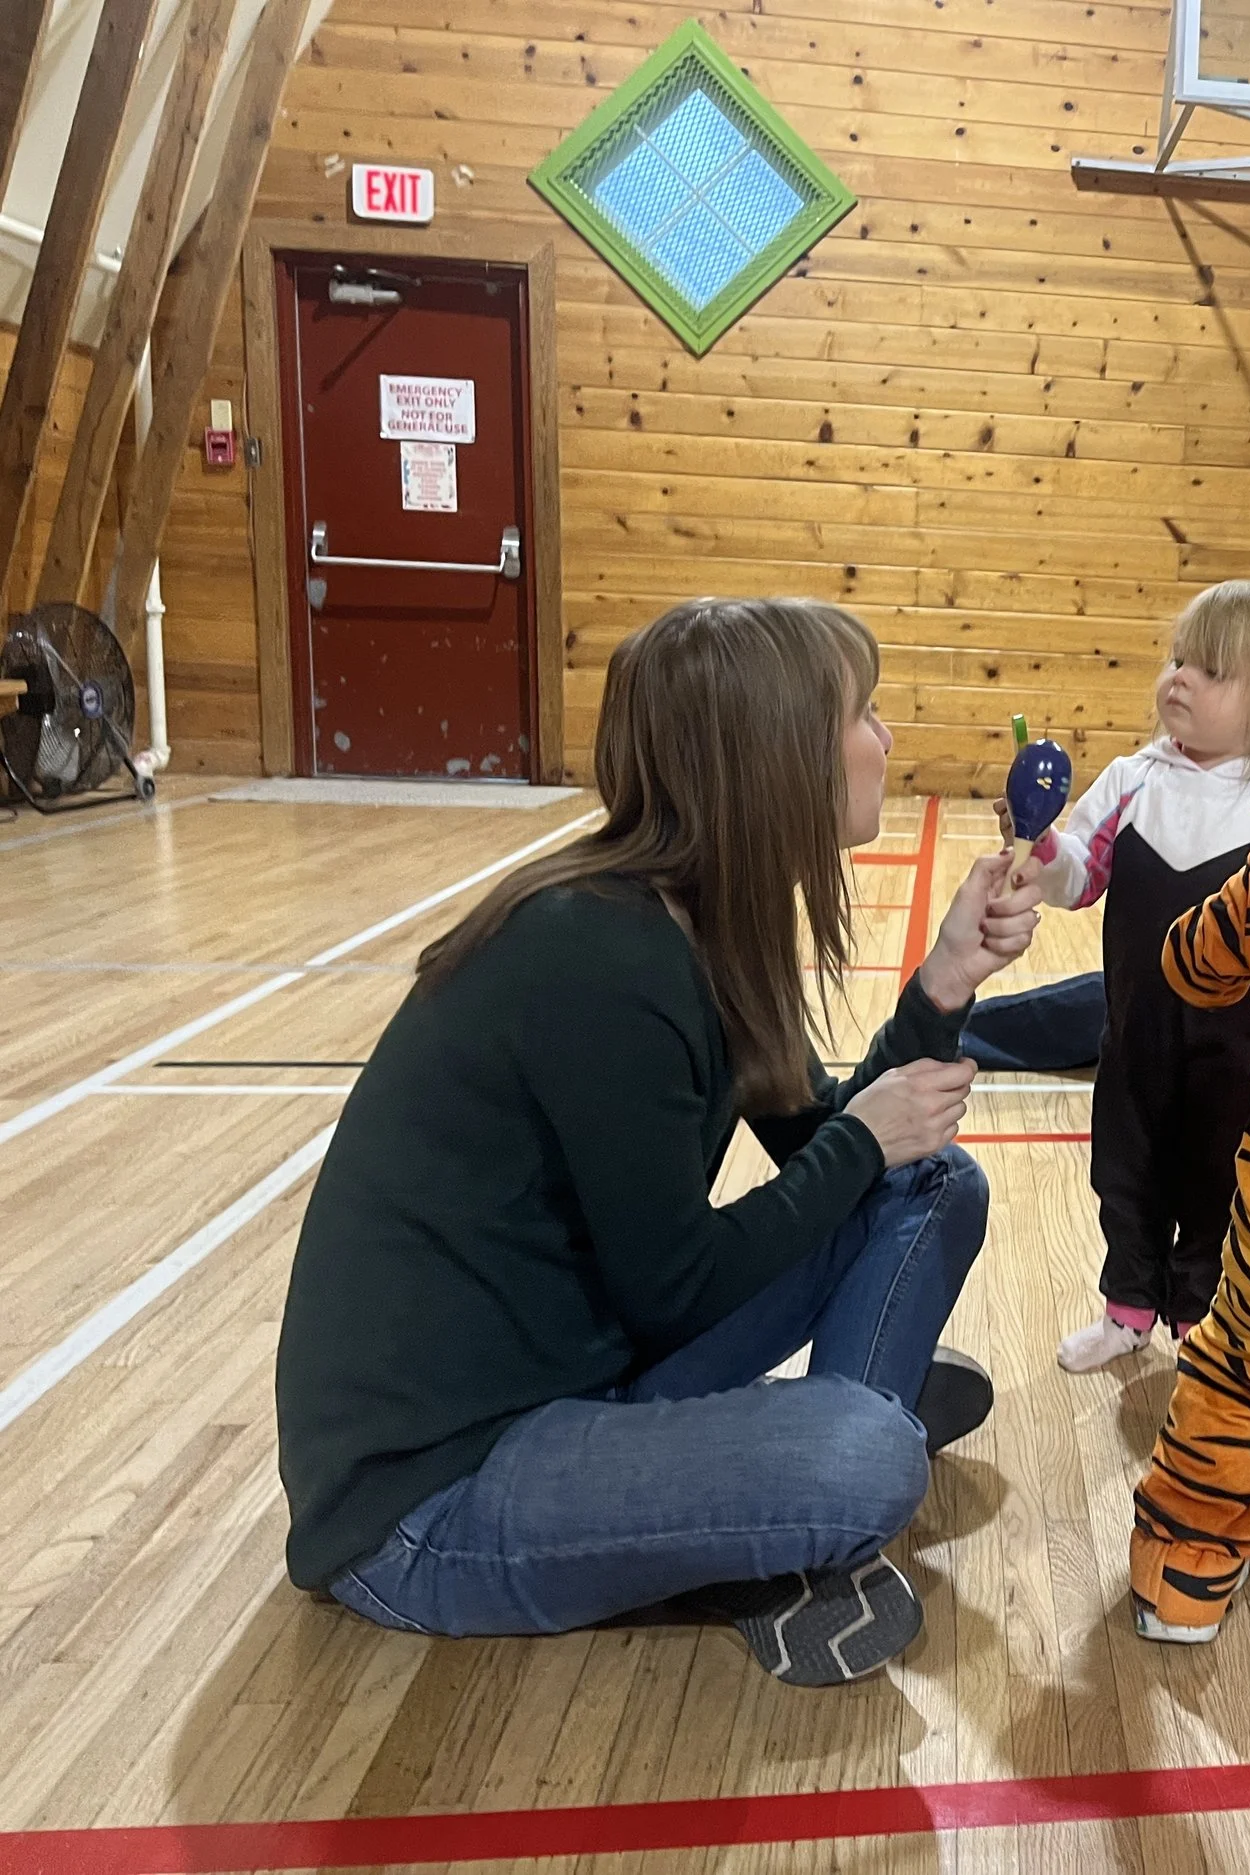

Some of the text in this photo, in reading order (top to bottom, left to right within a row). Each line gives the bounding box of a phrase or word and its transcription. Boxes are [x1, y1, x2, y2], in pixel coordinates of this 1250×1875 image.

[366, 170, 421, 214] EXIT
[389, 384, 462, 397] EMERGENCY
[396, 395, 456, 408] EXIT ONLY
[401, 409, 453, 422] NOT FOR
[387, 420, 469, 435] GENERAL USE
